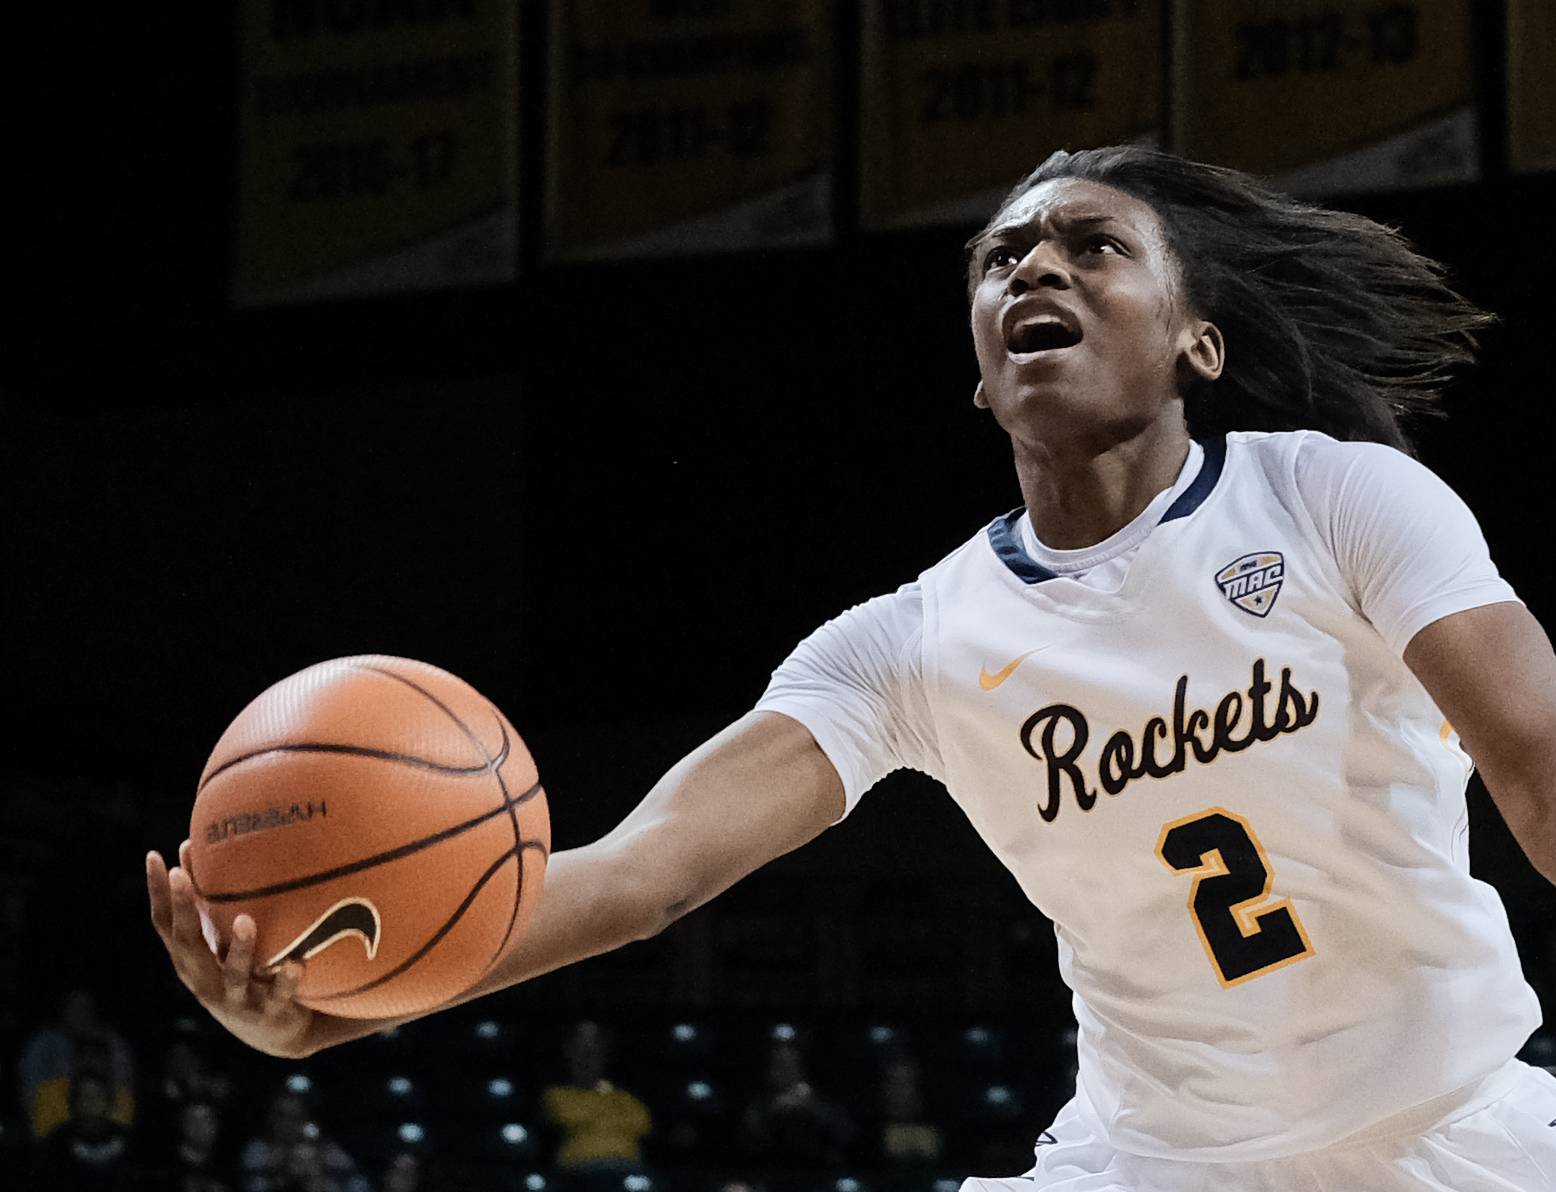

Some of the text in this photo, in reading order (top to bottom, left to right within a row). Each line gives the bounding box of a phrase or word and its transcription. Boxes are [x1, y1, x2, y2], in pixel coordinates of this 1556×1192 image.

[1223, 564, 1284, 601] MAC
[1019, 657, 1319, 823] Rockets
[1154, 805, 1317, 990] 2
